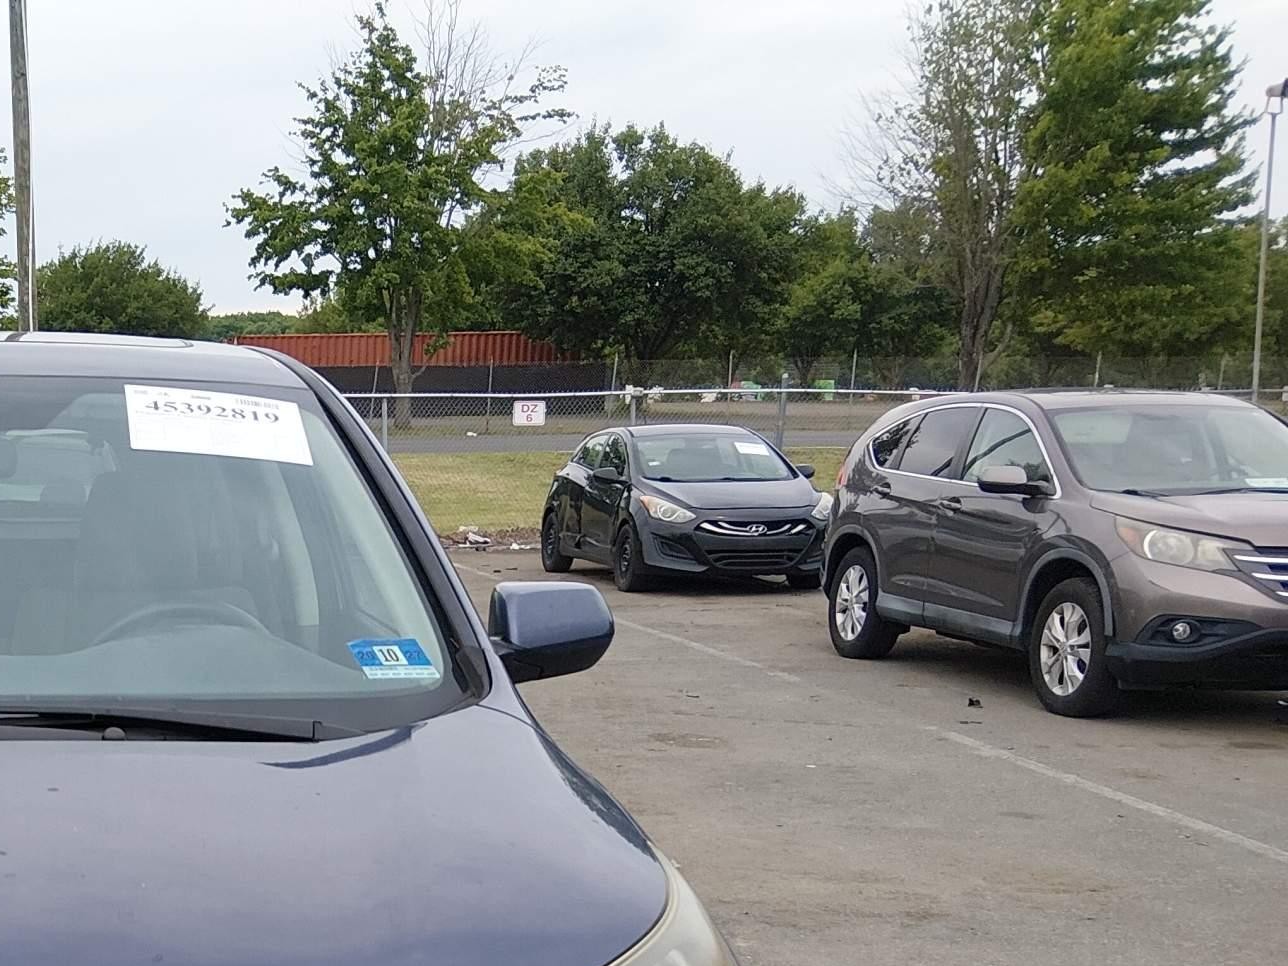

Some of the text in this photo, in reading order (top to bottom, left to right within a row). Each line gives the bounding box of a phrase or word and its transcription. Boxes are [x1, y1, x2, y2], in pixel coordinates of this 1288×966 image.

[145, 400, 280, 424] 45392819
[521, 404, 538, 413] DZ
[526, 414, 533, 422] 6
[378, 648, 400, 662] 10
